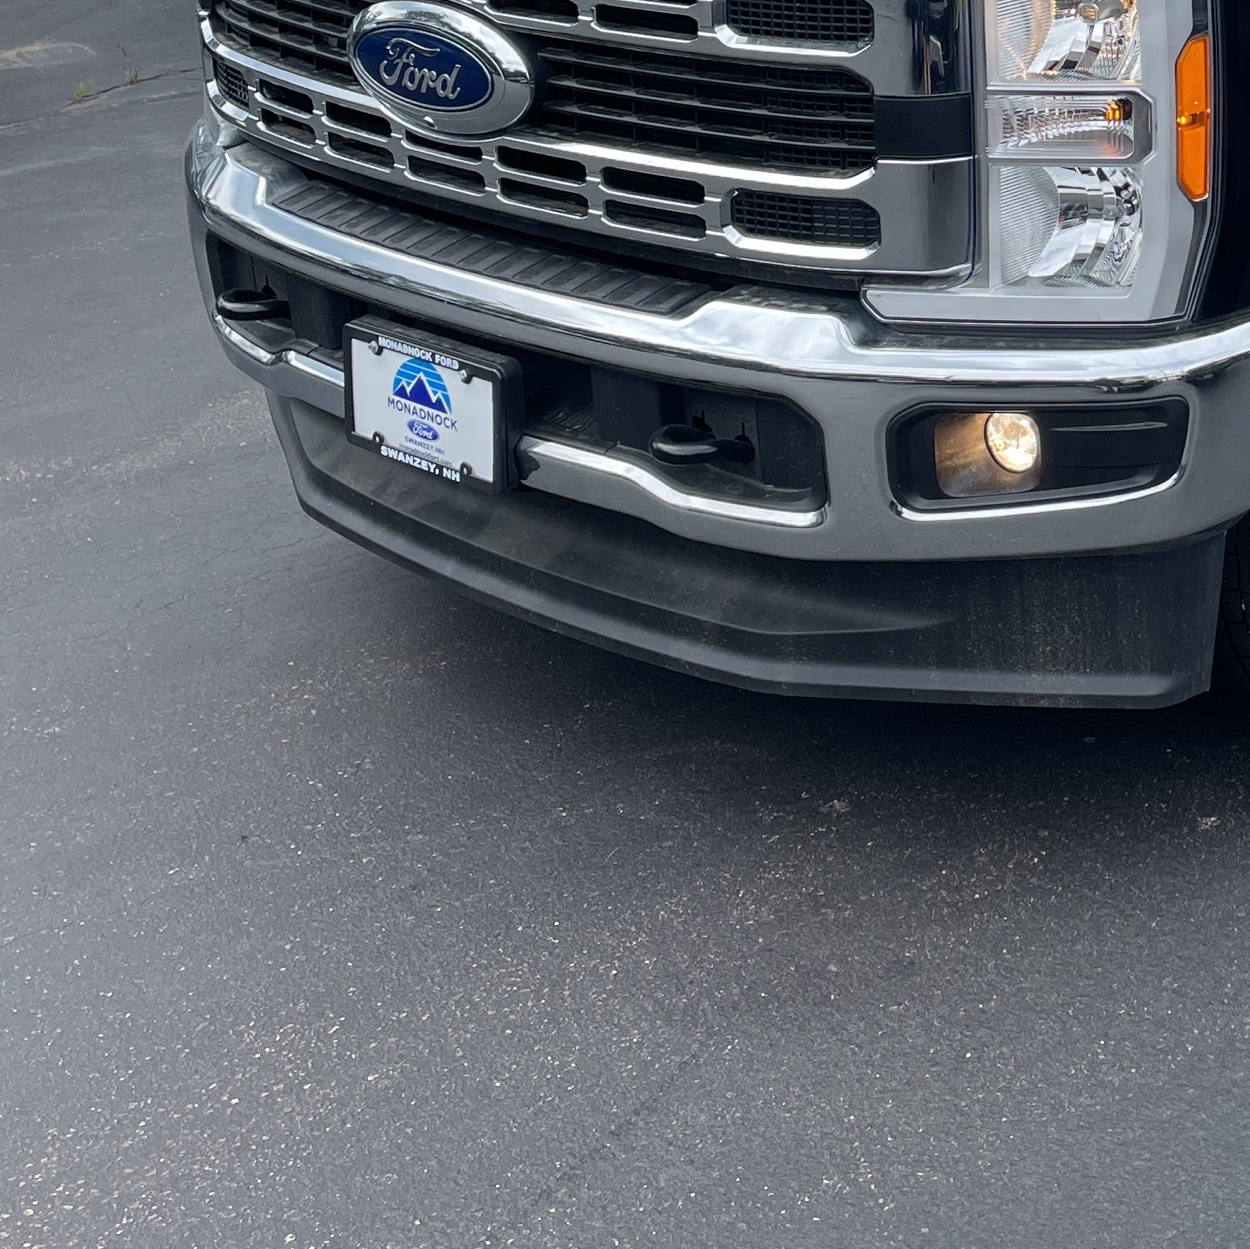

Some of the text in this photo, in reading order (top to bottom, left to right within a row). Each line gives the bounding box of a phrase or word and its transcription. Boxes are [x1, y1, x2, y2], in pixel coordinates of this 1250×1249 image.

[379, 37, 462, 100] Ford
[378, 336, 460, 370] MONADNOCK FORD
[387, 396, 458, 432] MONADNOCK
[412, 421, 434, 440] Ford
[380, 445, 461, 483] SWANZEY, NH
